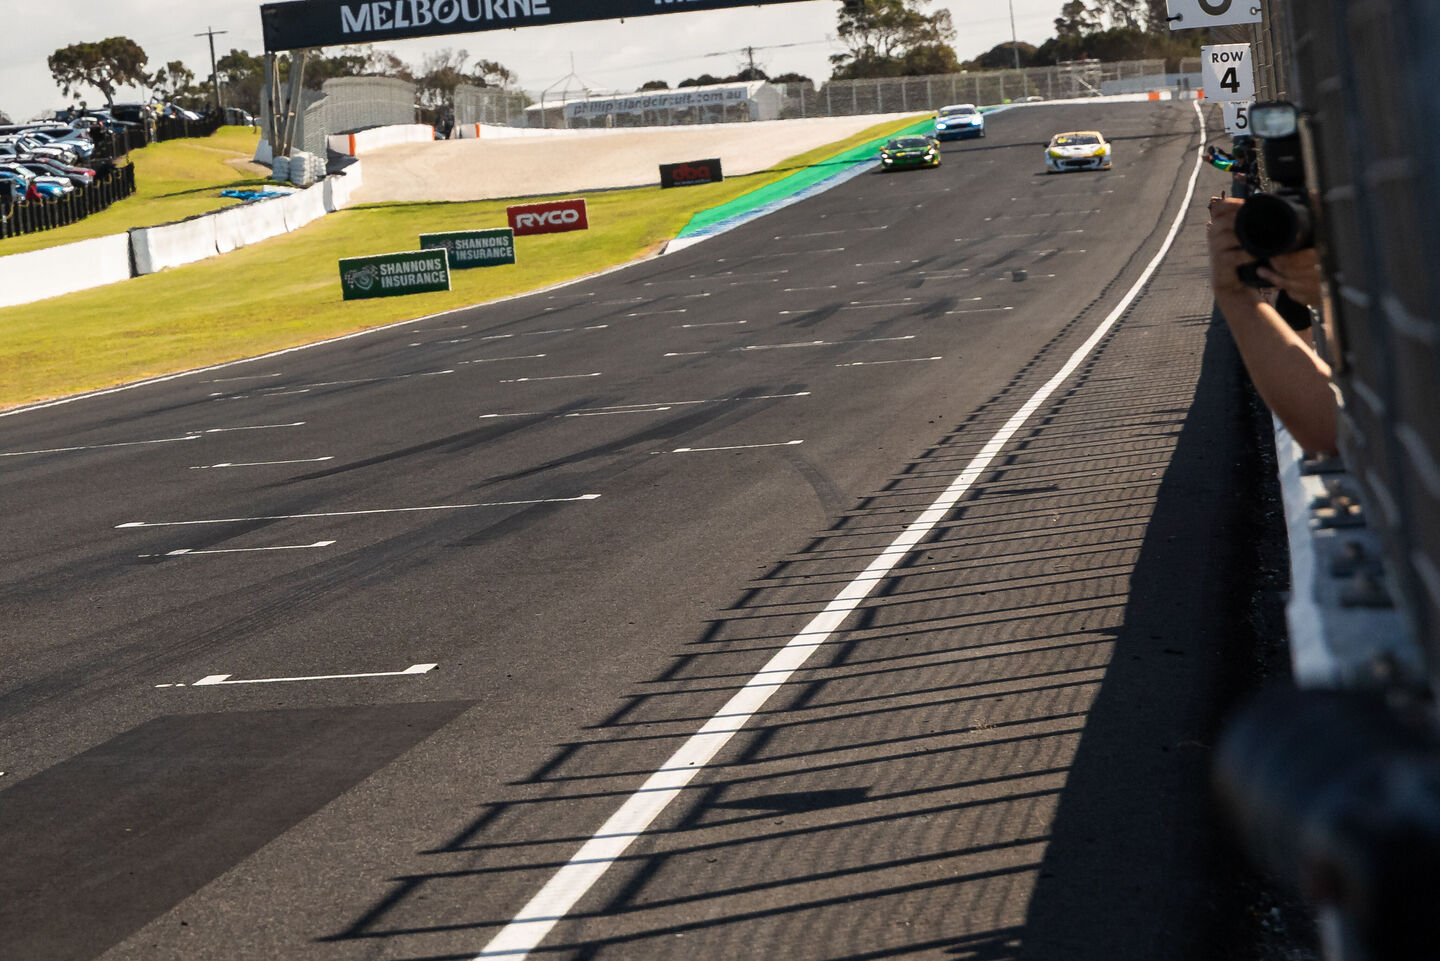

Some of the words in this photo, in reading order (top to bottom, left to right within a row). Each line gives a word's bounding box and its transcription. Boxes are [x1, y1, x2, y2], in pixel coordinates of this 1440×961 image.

[1211, 51, 1244, 64] ROW
[1220, 67, 1240, 93] 4
[1236, 107, 1247, 129] 5
[673, 164, 710, 181] dba
[516, 208, 579, 229] RYCO
[455, 235, 509, 250] SHANNONS
[456, 246, 513, 261] INSURANCE
[380, 258, 442, 277] SHANNONS
[381, 270, 446, 289] INSURANCE
